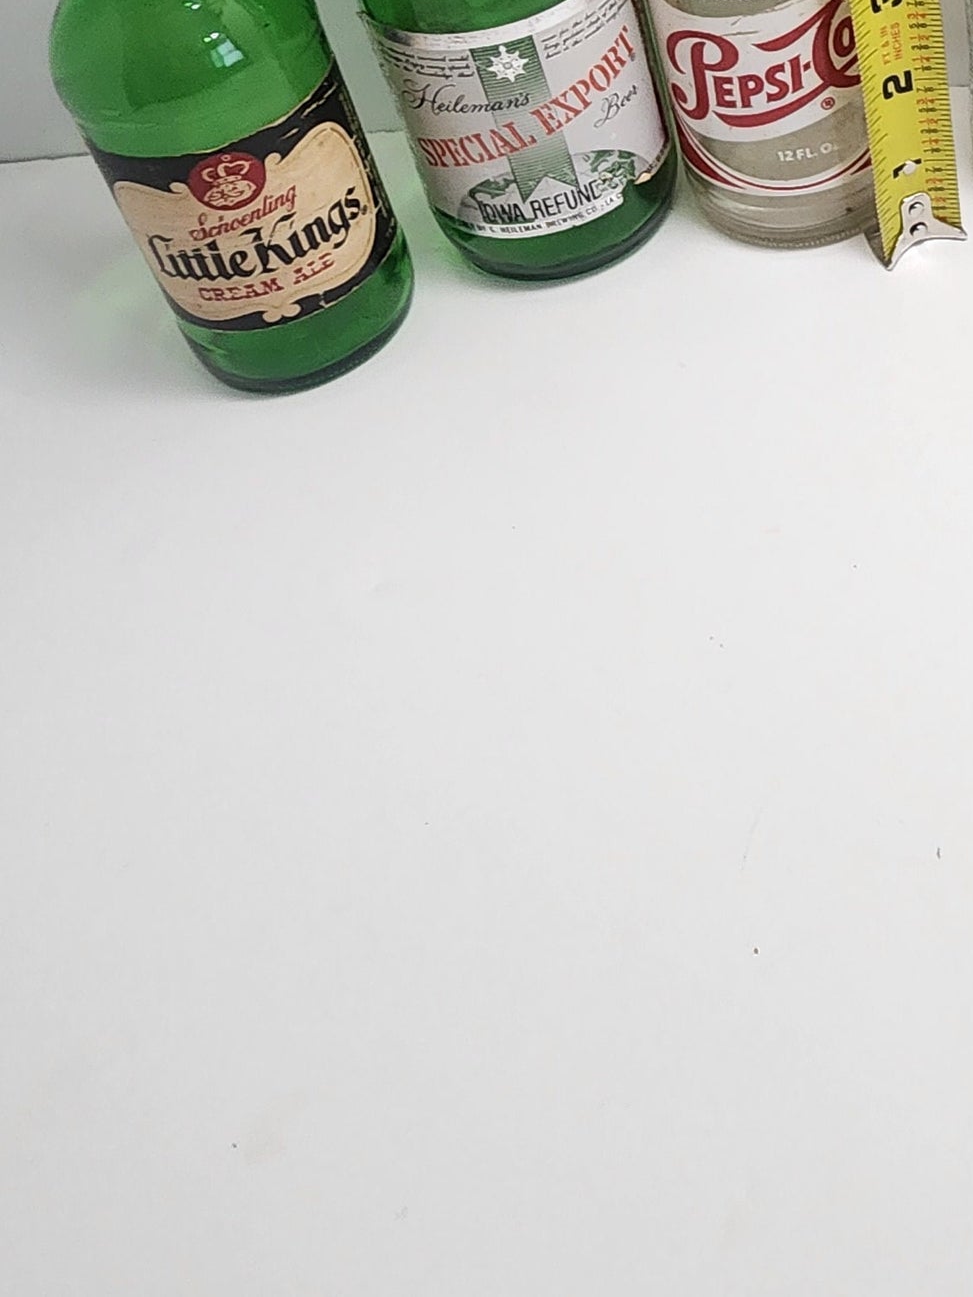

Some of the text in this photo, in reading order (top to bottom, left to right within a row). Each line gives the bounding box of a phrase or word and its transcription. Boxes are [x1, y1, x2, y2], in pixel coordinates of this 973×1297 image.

[401, 79, 531, 115] Heileman's
[417, 120, 538, 169] SPECIAL
[529, 24, 634, 137] EXPORT
[593, 84, 640, 129] Beer
[882, 69, 914, 100] 2
[189, 185, 297, 241] Schoenling
[197, 252, 336, 302] CREAM ALE
